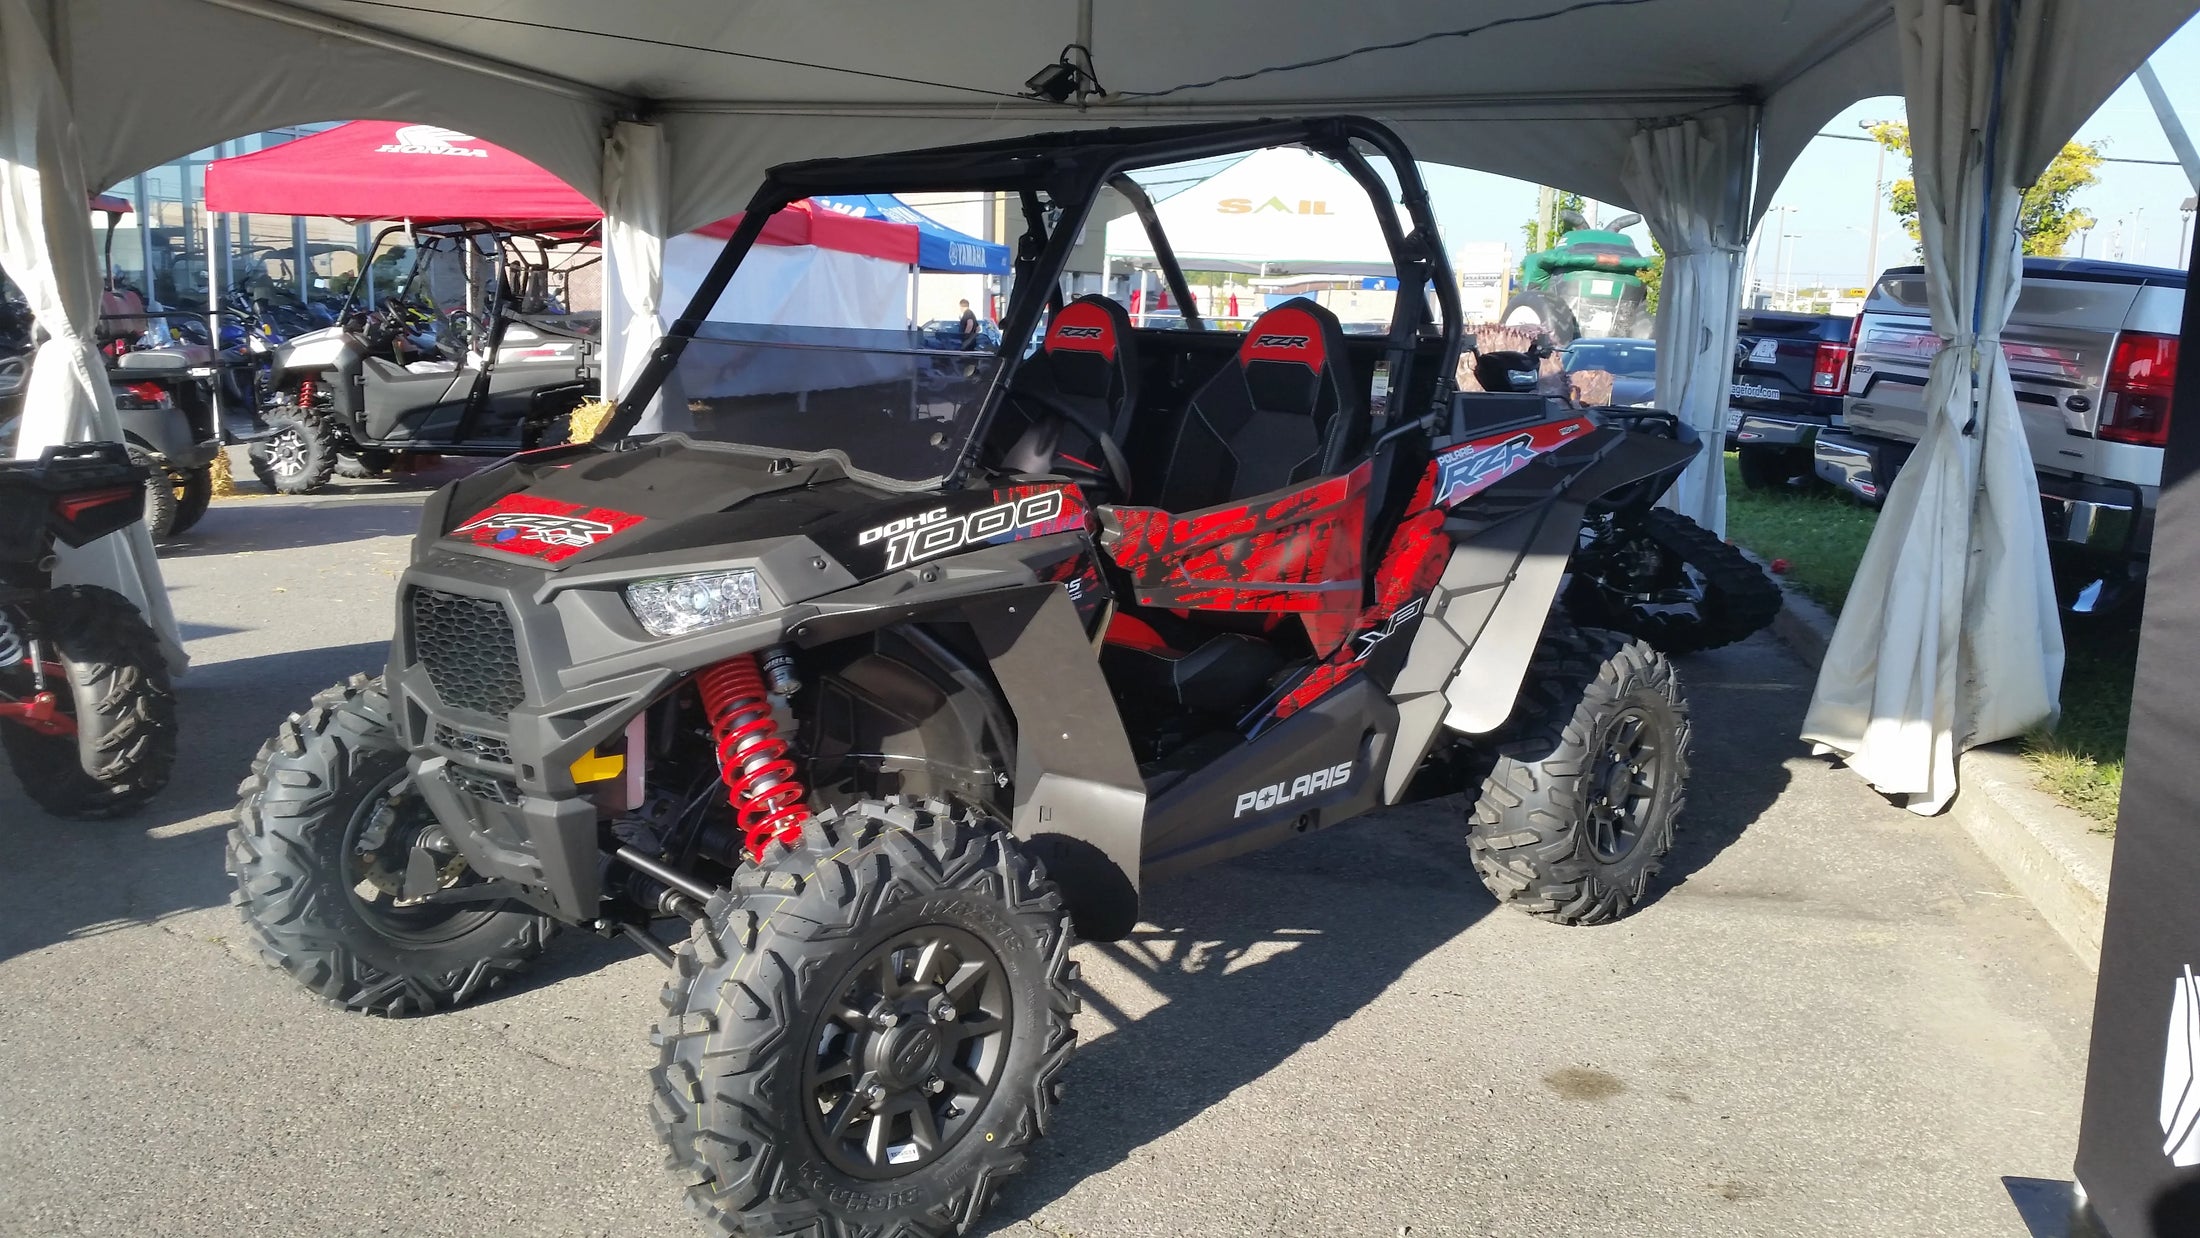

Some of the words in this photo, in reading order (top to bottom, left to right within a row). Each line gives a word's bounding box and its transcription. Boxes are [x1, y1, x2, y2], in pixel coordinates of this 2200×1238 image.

[375, 144, 488, 157] HONDA
[1217, 196, 1335, 215] SAIL
[957, 243, 987, 268] YAMAHA
[1055, 326, 1104, 339] RZR
[1251, 334, 1310, 349] RZR
[1437, 444, 1475, 466] POLARIS
[1435, 433, 1539, 505] RZR
[859, 507, 948, 546] DOHC
[886, 490, 1063, 571] 1000
[1354, 597, 1424, 662] XP
[1234, 761, 1352, 818] POLARIS
